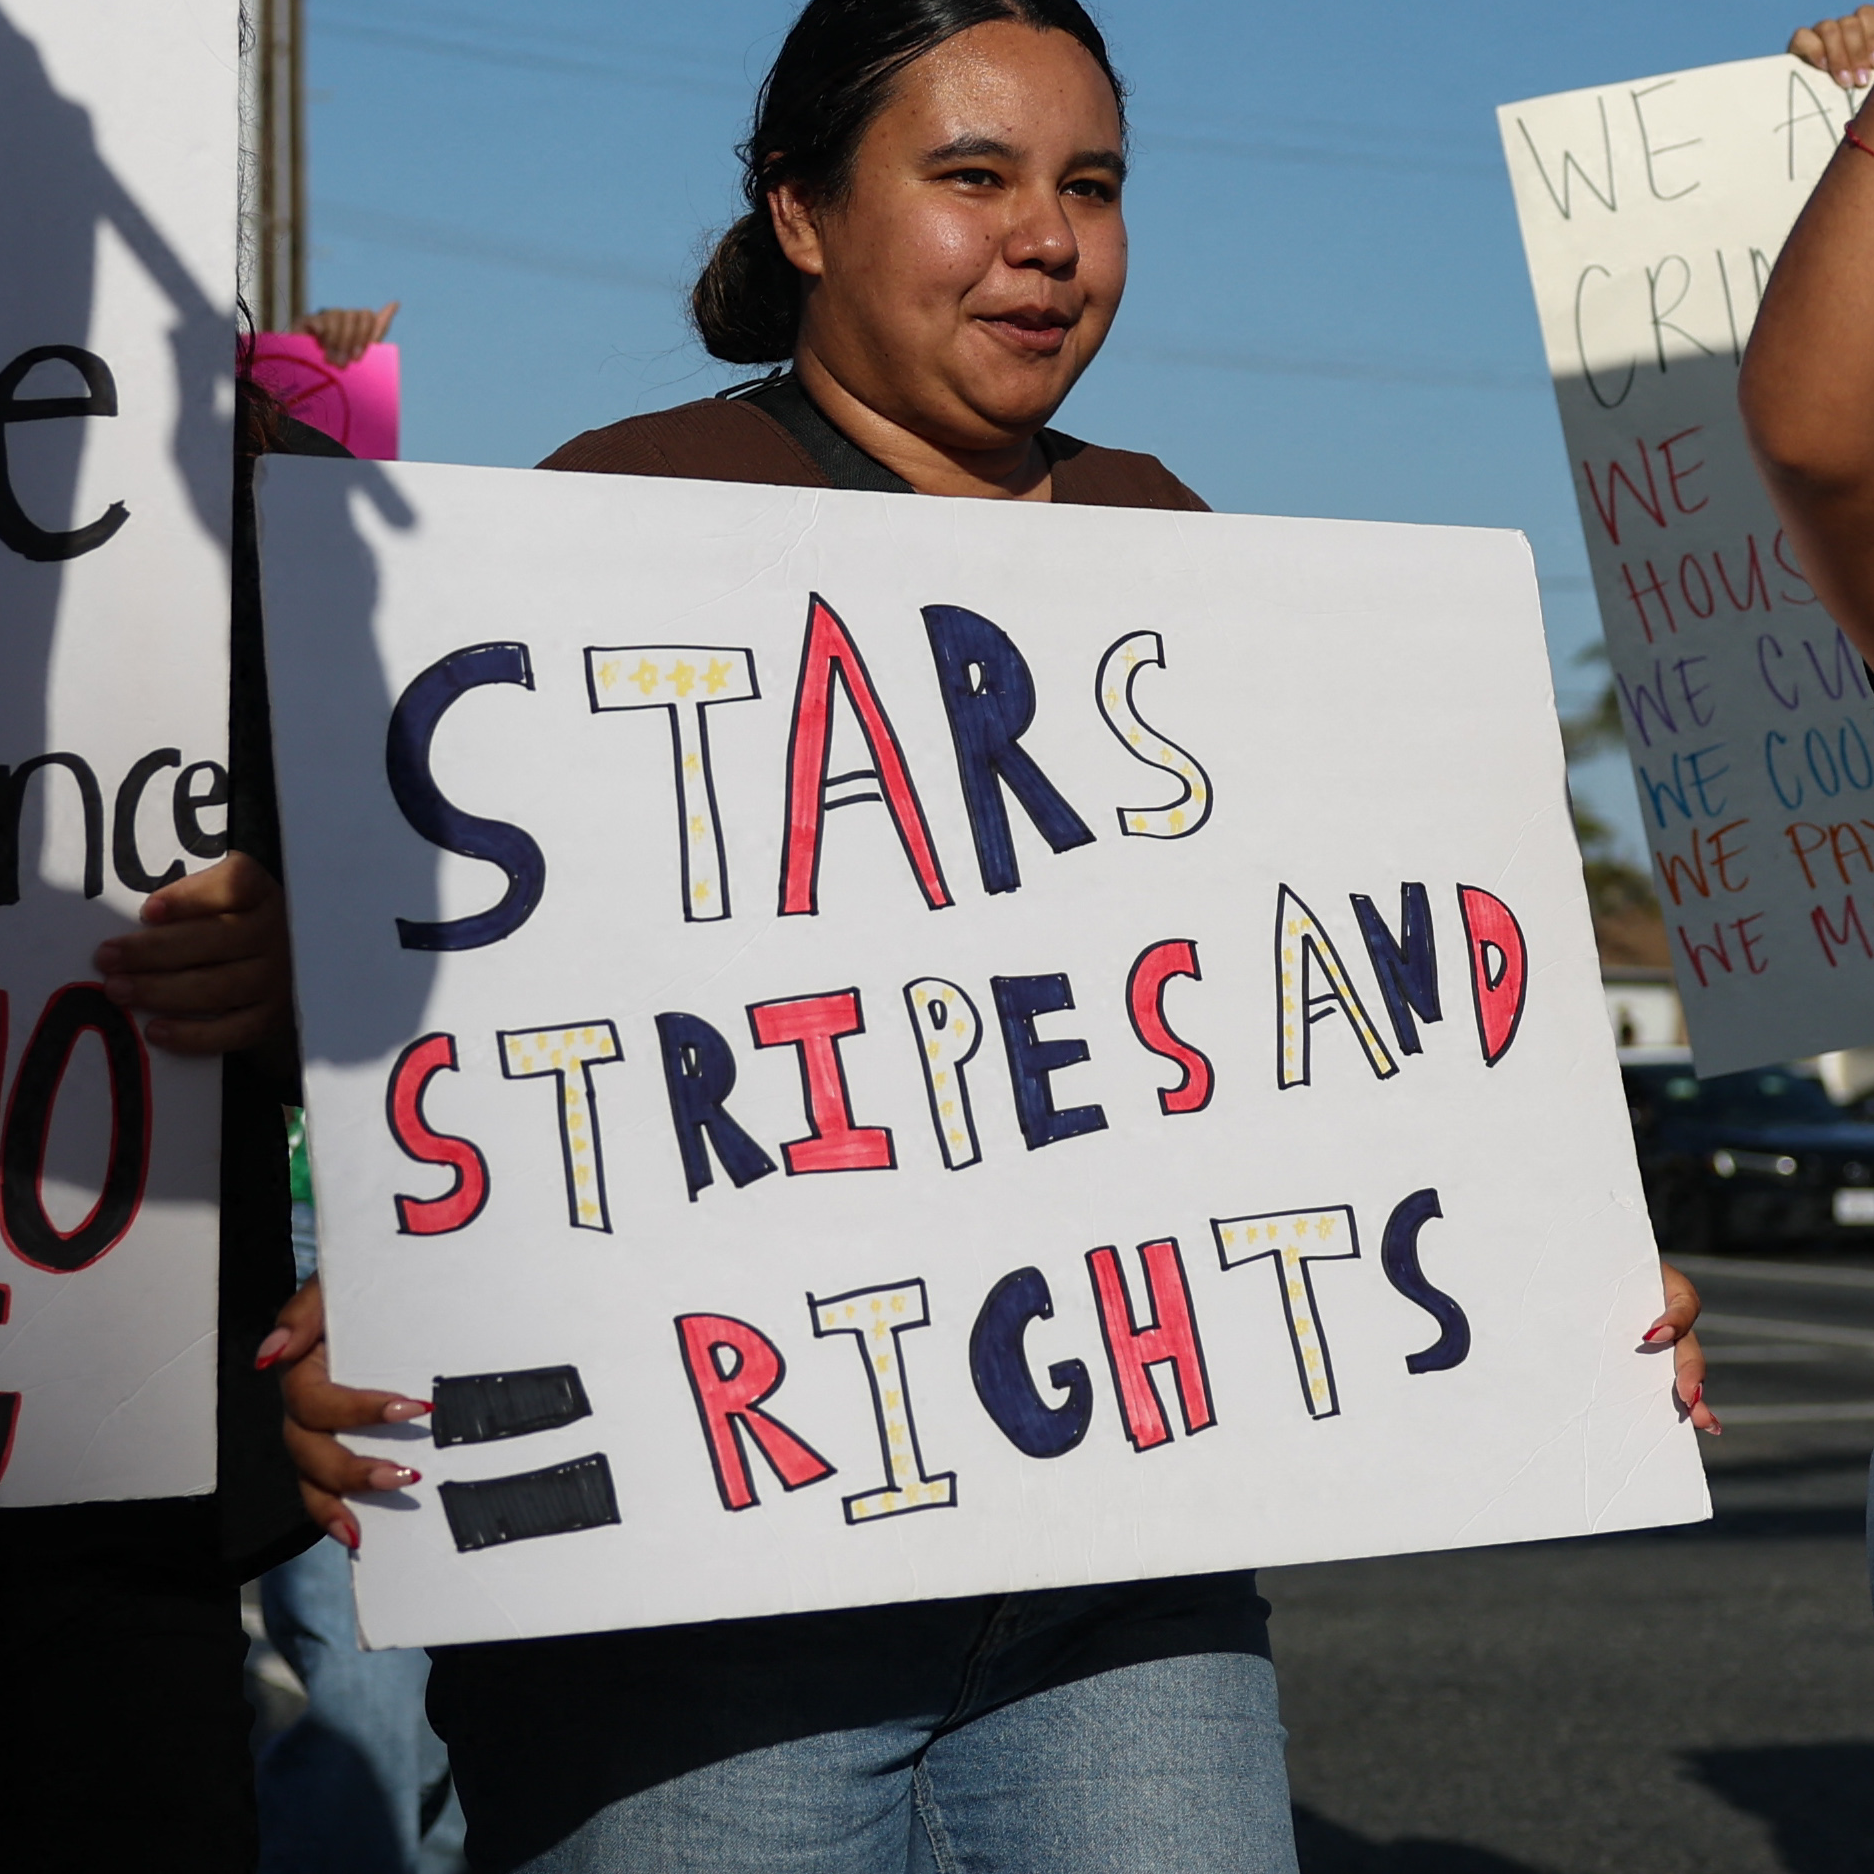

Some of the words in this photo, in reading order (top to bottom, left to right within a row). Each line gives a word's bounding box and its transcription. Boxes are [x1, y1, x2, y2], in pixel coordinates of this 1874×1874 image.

[1517, 79, 1703, 220] WE
[1583, 425, 1709, 546] WE
[1616, 655, 1716, 748] WE
[386, 592, 1214, 951] STARS
[1639, 742, 1730, 829] WE
[1656, 819, 1750, 906] WE
[1678, 912, 1769, 988] WE
[386, 939, 1216, 1235] STRIPES
[1276, 882, 1528, 1089] AND
[674, 1188, 1472, 1525] RIGHTS
